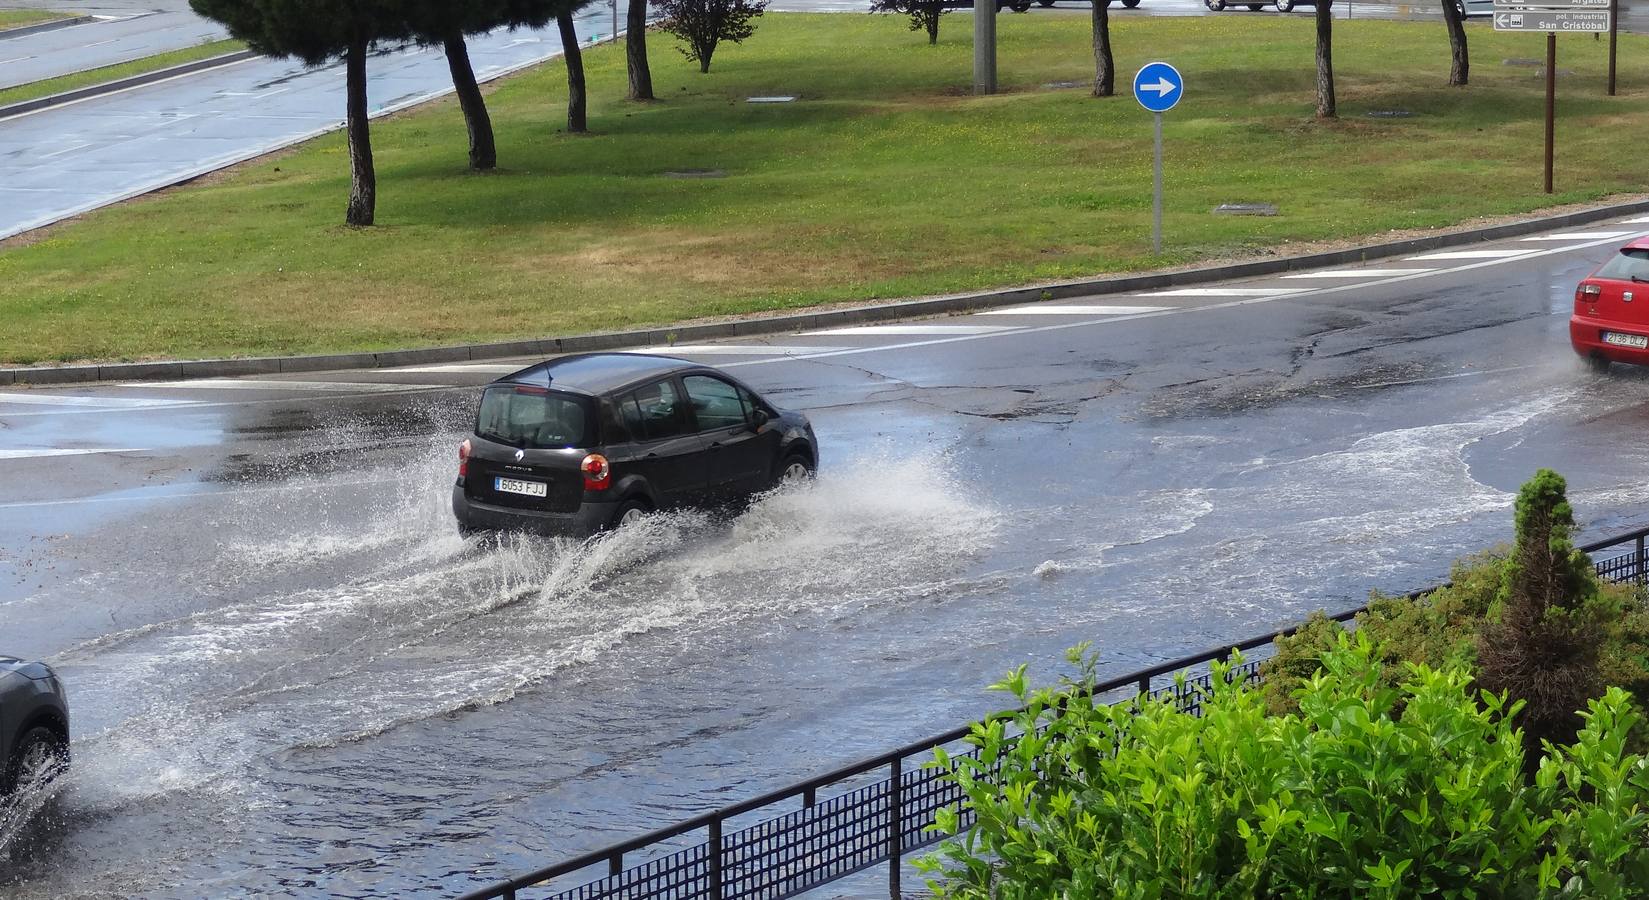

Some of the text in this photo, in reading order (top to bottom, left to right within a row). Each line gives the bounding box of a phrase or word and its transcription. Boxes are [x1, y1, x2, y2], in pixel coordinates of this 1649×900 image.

[1539, 21, 1606, 29] San Cristóbal
[502, 480, 544, 494] 6053 FJJ
